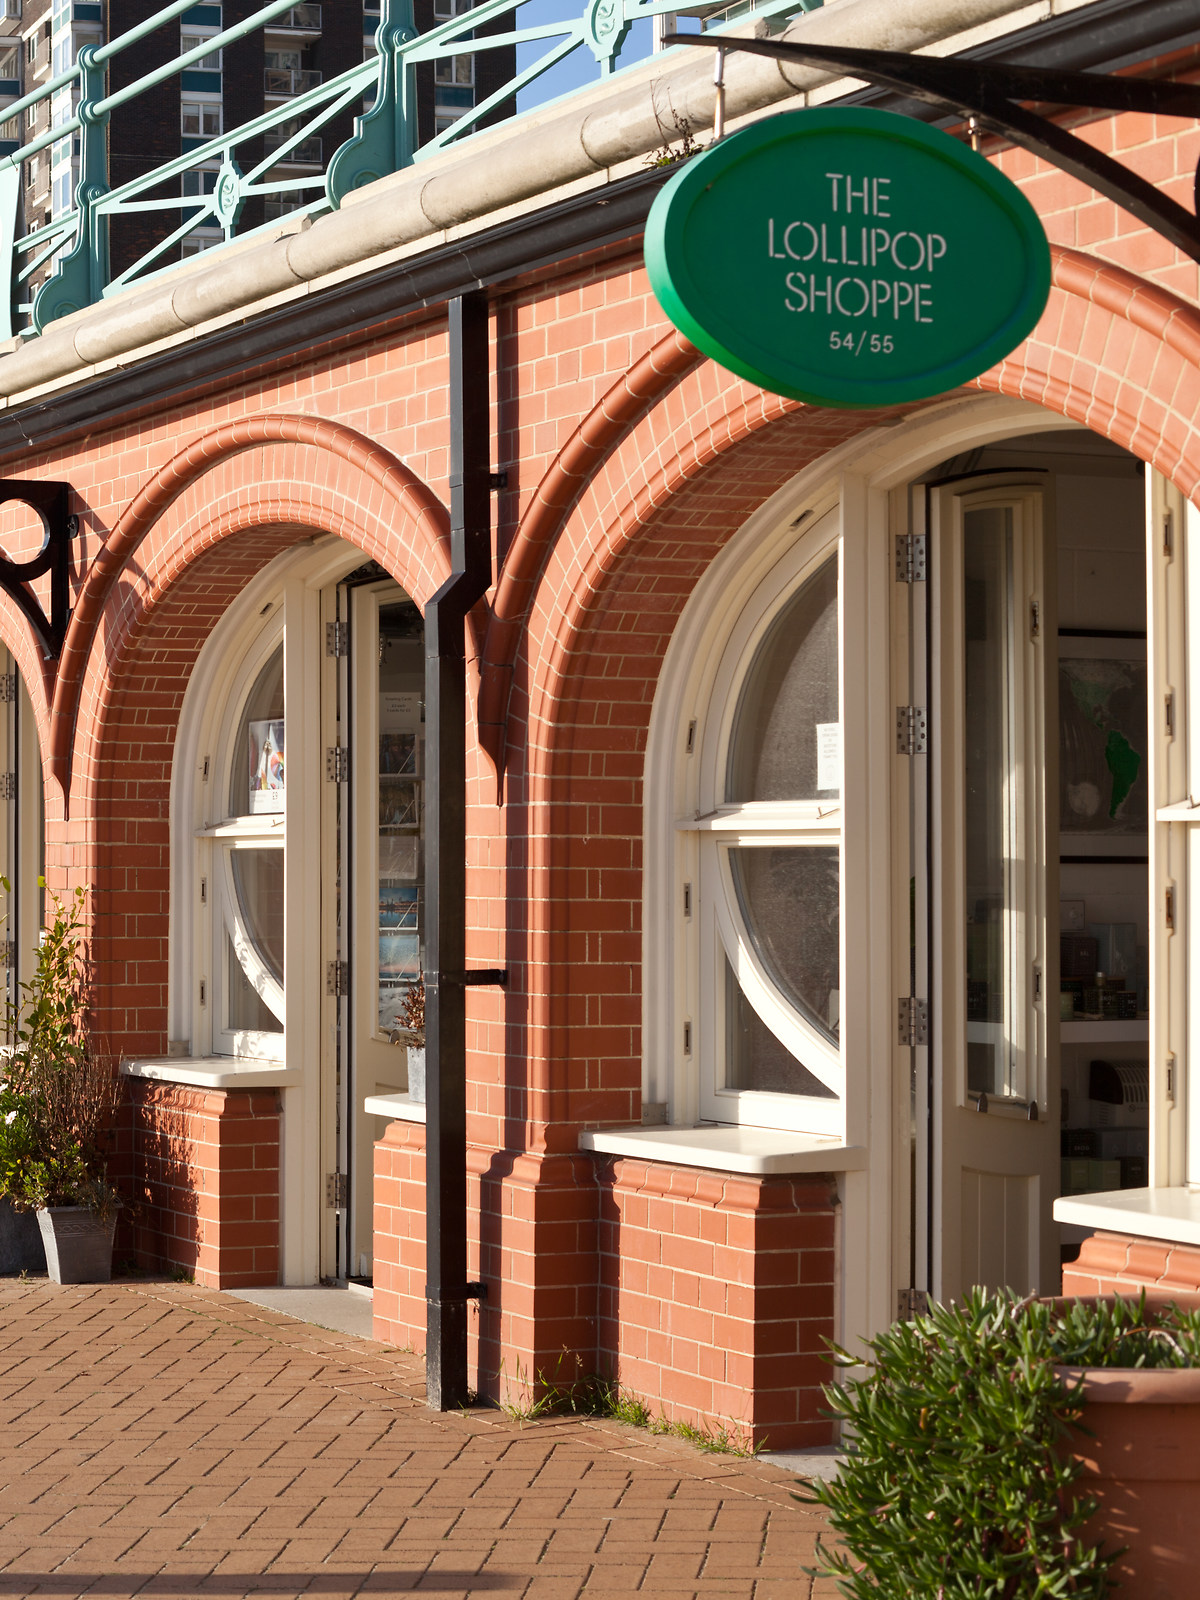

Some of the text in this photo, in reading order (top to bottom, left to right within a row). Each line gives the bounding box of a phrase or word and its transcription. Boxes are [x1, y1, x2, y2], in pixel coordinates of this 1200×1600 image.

[825, 172, 891, 217] THE
[768, 218, 947, 272] LOLLIPOP
[785, 272, 933, 323] SHOPPE
[829, 330, 894, 356] 54/55
